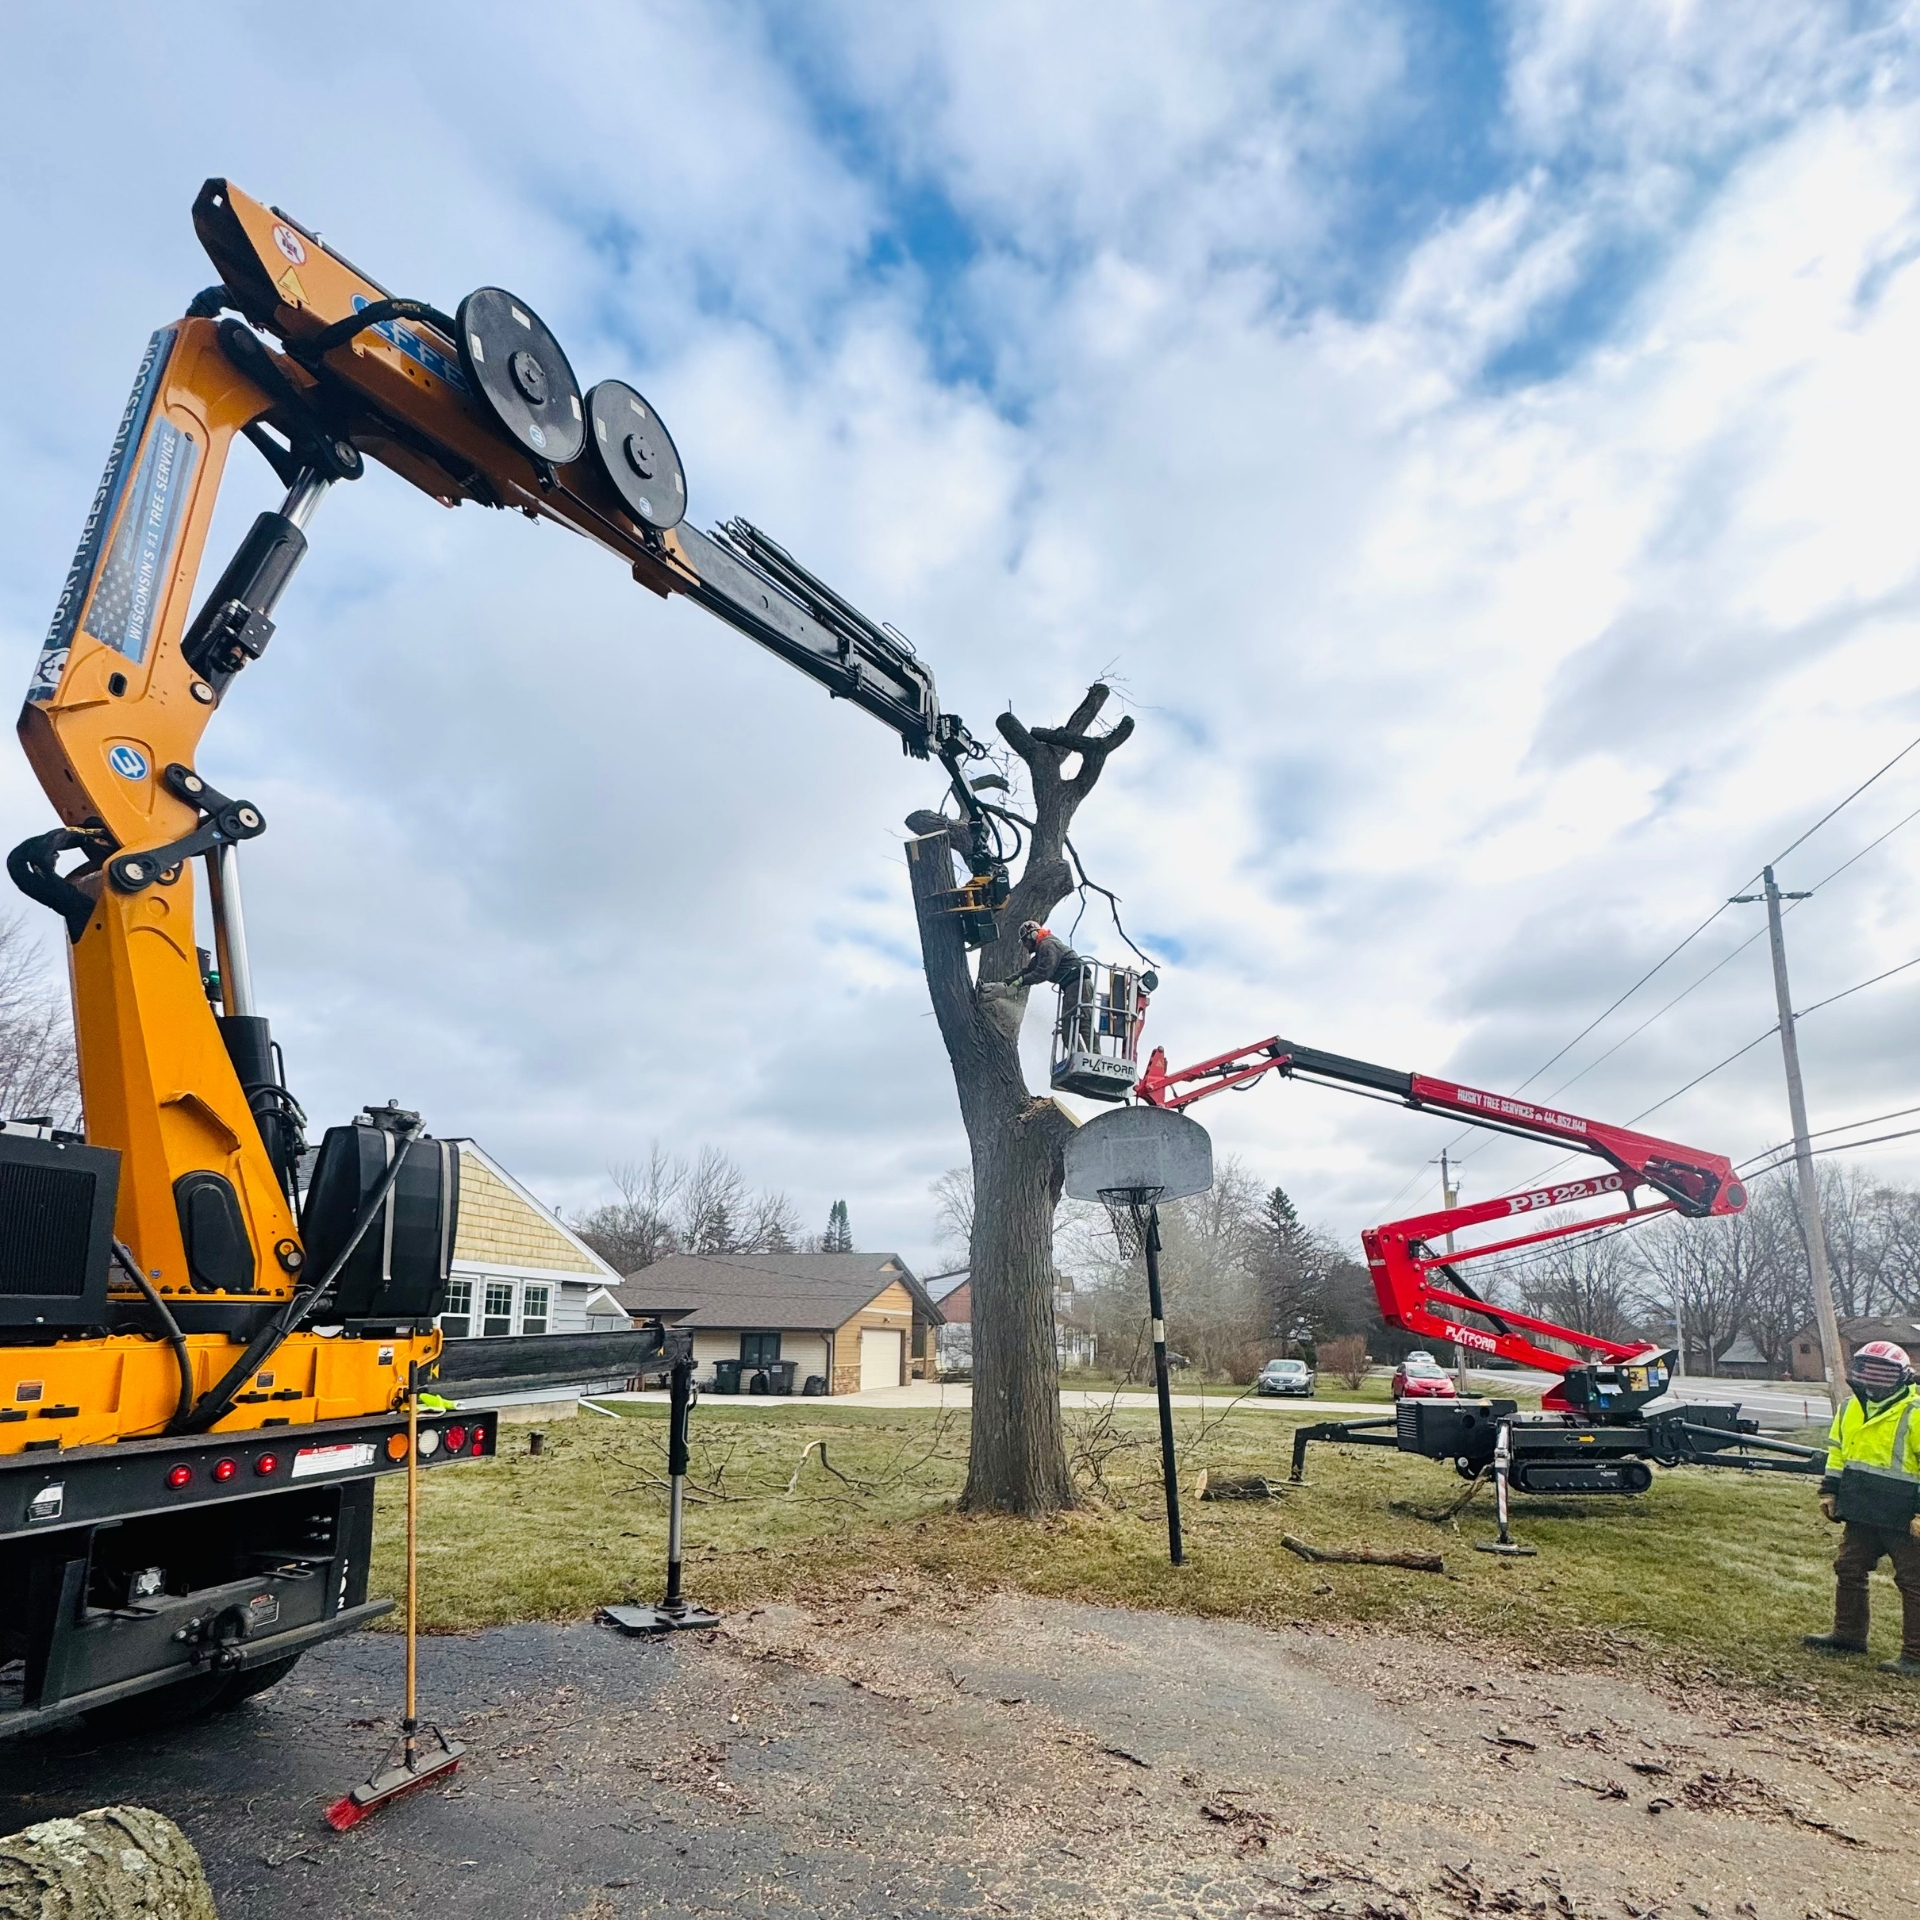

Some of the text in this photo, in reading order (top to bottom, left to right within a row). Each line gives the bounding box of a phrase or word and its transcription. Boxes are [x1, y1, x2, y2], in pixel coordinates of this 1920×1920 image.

[156, 432, 176, 491] SERVICE
[149, 491, 165, 528] TREE
[128, 546, 155, 641] WISCONSIN'S
[1082, 1058, 1135, 1076] PLATFORM
[1457, 1089, 1482, 1106] HUSKY
[1483, 1094, 1500, 1111] TREE
[1501, 1100, 1534, 1120] SERVICES
[1506, 1175, 1623, 1215] PB 22.10
[1445, 1325, 1497, 1354] PLATFORM
